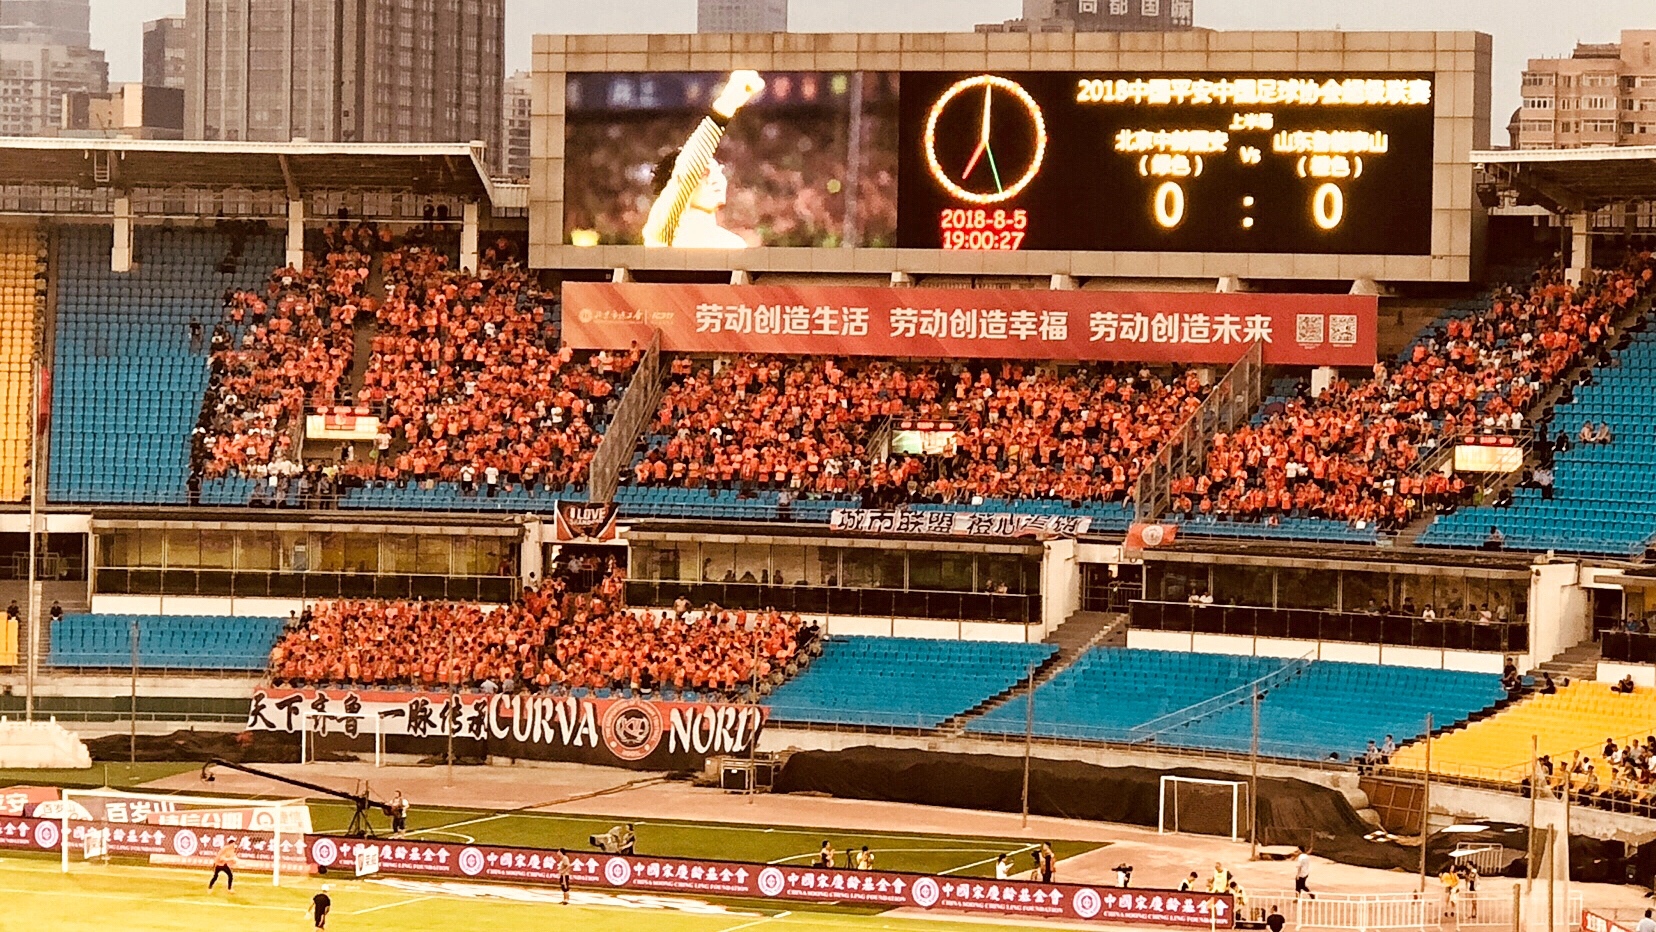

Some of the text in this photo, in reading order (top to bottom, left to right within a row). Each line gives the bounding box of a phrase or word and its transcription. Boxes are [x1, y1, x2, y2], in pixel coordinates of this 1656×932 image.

[1155, 181, 1184, 227] 0
[1313, 182, 1344, 229] 0
[941, 208, 1027, 230] 2018-8-5
[942, 230, 1026, 250] 19:00:27
[695, 303, 1273, 344] 劳动创造生活 劳动创造幸福 劳动创造未来
[576, 507, 606, 520] LOVE
[488, 693, 599, 748] CURVA
[668, 704, 762, 754] NORD
[486, 851, 600, 874] 中國宋慶齡金會
